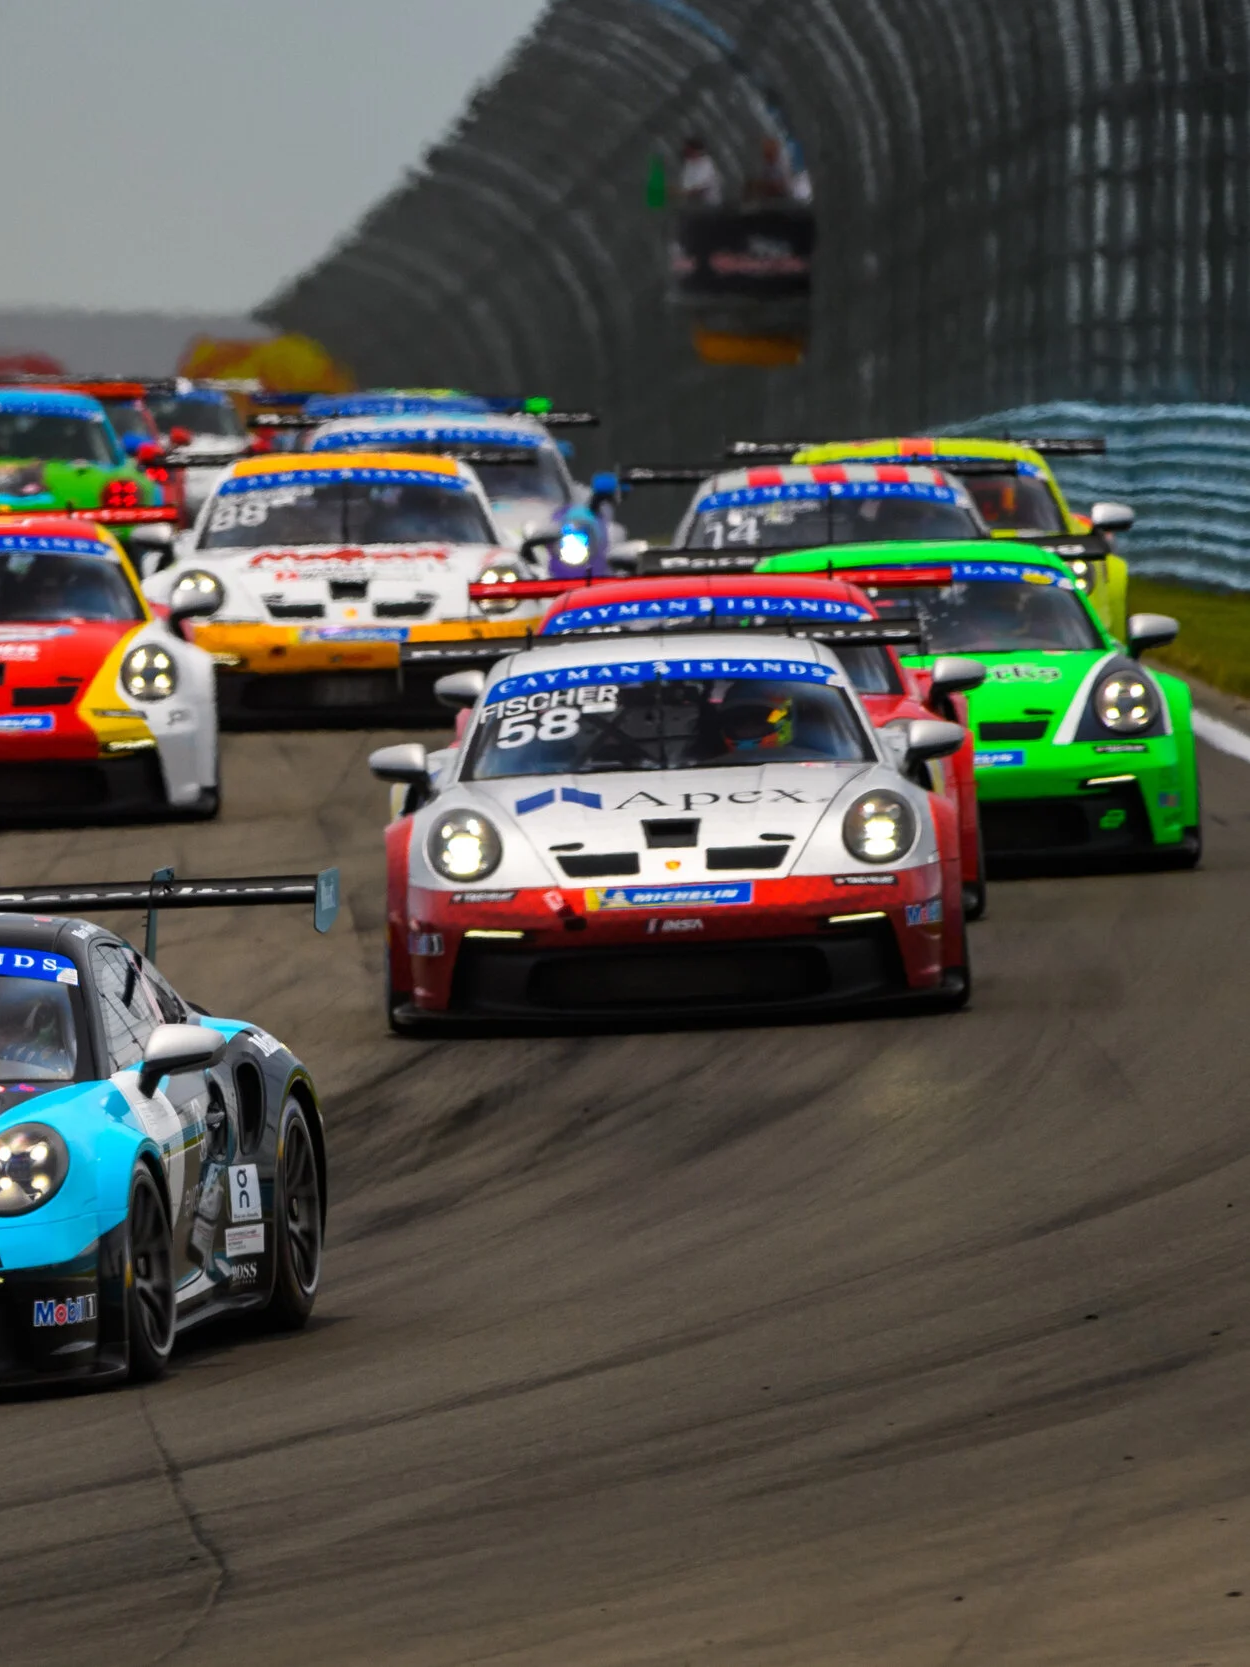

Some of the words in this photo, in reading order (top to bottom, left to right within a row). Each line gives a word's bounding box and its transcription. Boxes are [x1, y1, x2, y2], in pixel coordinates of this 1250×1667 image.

[556, 599, 688, 626] CAYMAN
[726, 598, 861, 617] ISLANDS
[498, 664, 641, 694] CAYMAN
[682, 661, 827, 678] ISLANDS
[480, 684, 620, 724] FISCHER
[496, 706, 581, 749] 58
[614, 788, 812, 811] Apex
[632, 887, 740, 904] MICHELIN
[33, 1295, 84, 1327] Mobil
